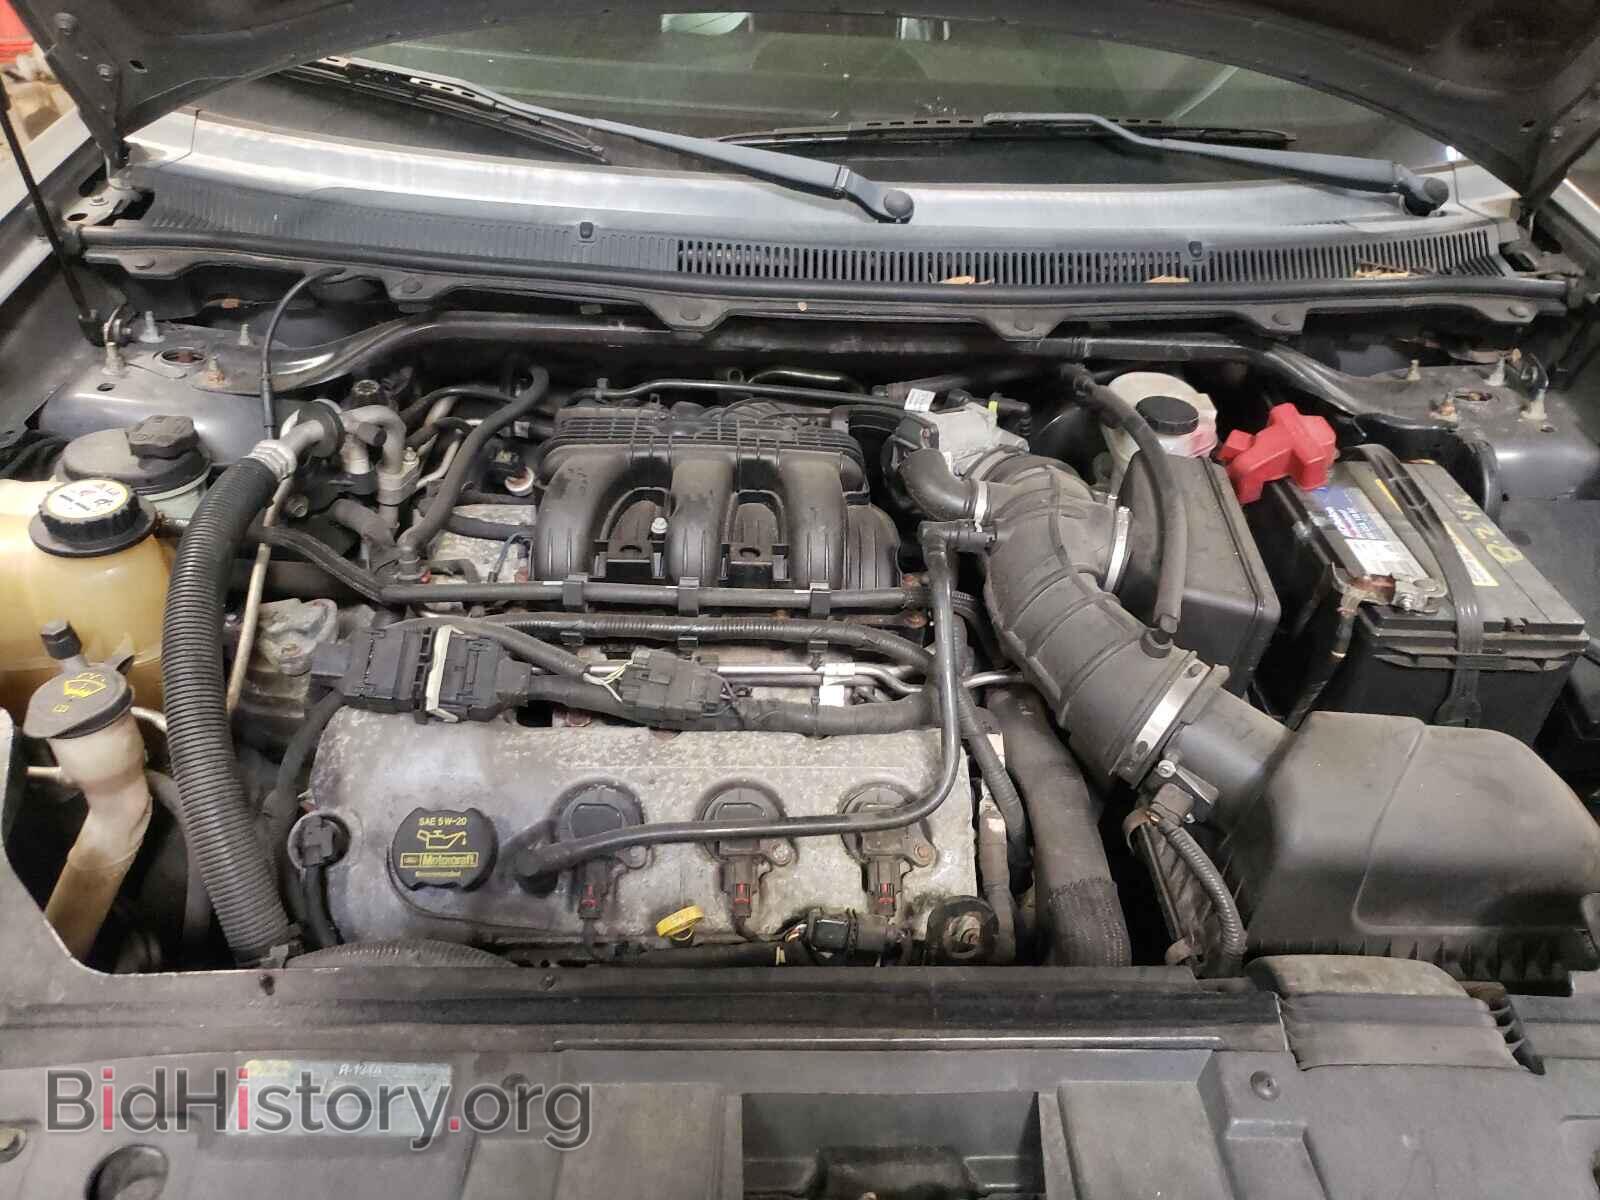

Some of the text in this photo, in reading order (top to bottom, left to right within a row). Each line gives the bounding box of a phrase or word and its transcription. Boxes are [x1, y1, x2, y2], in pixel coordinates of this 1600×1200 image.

[418, 816, 467, 826] SAE 5W-20
[422, 853, 475, 866] Motorcraft
